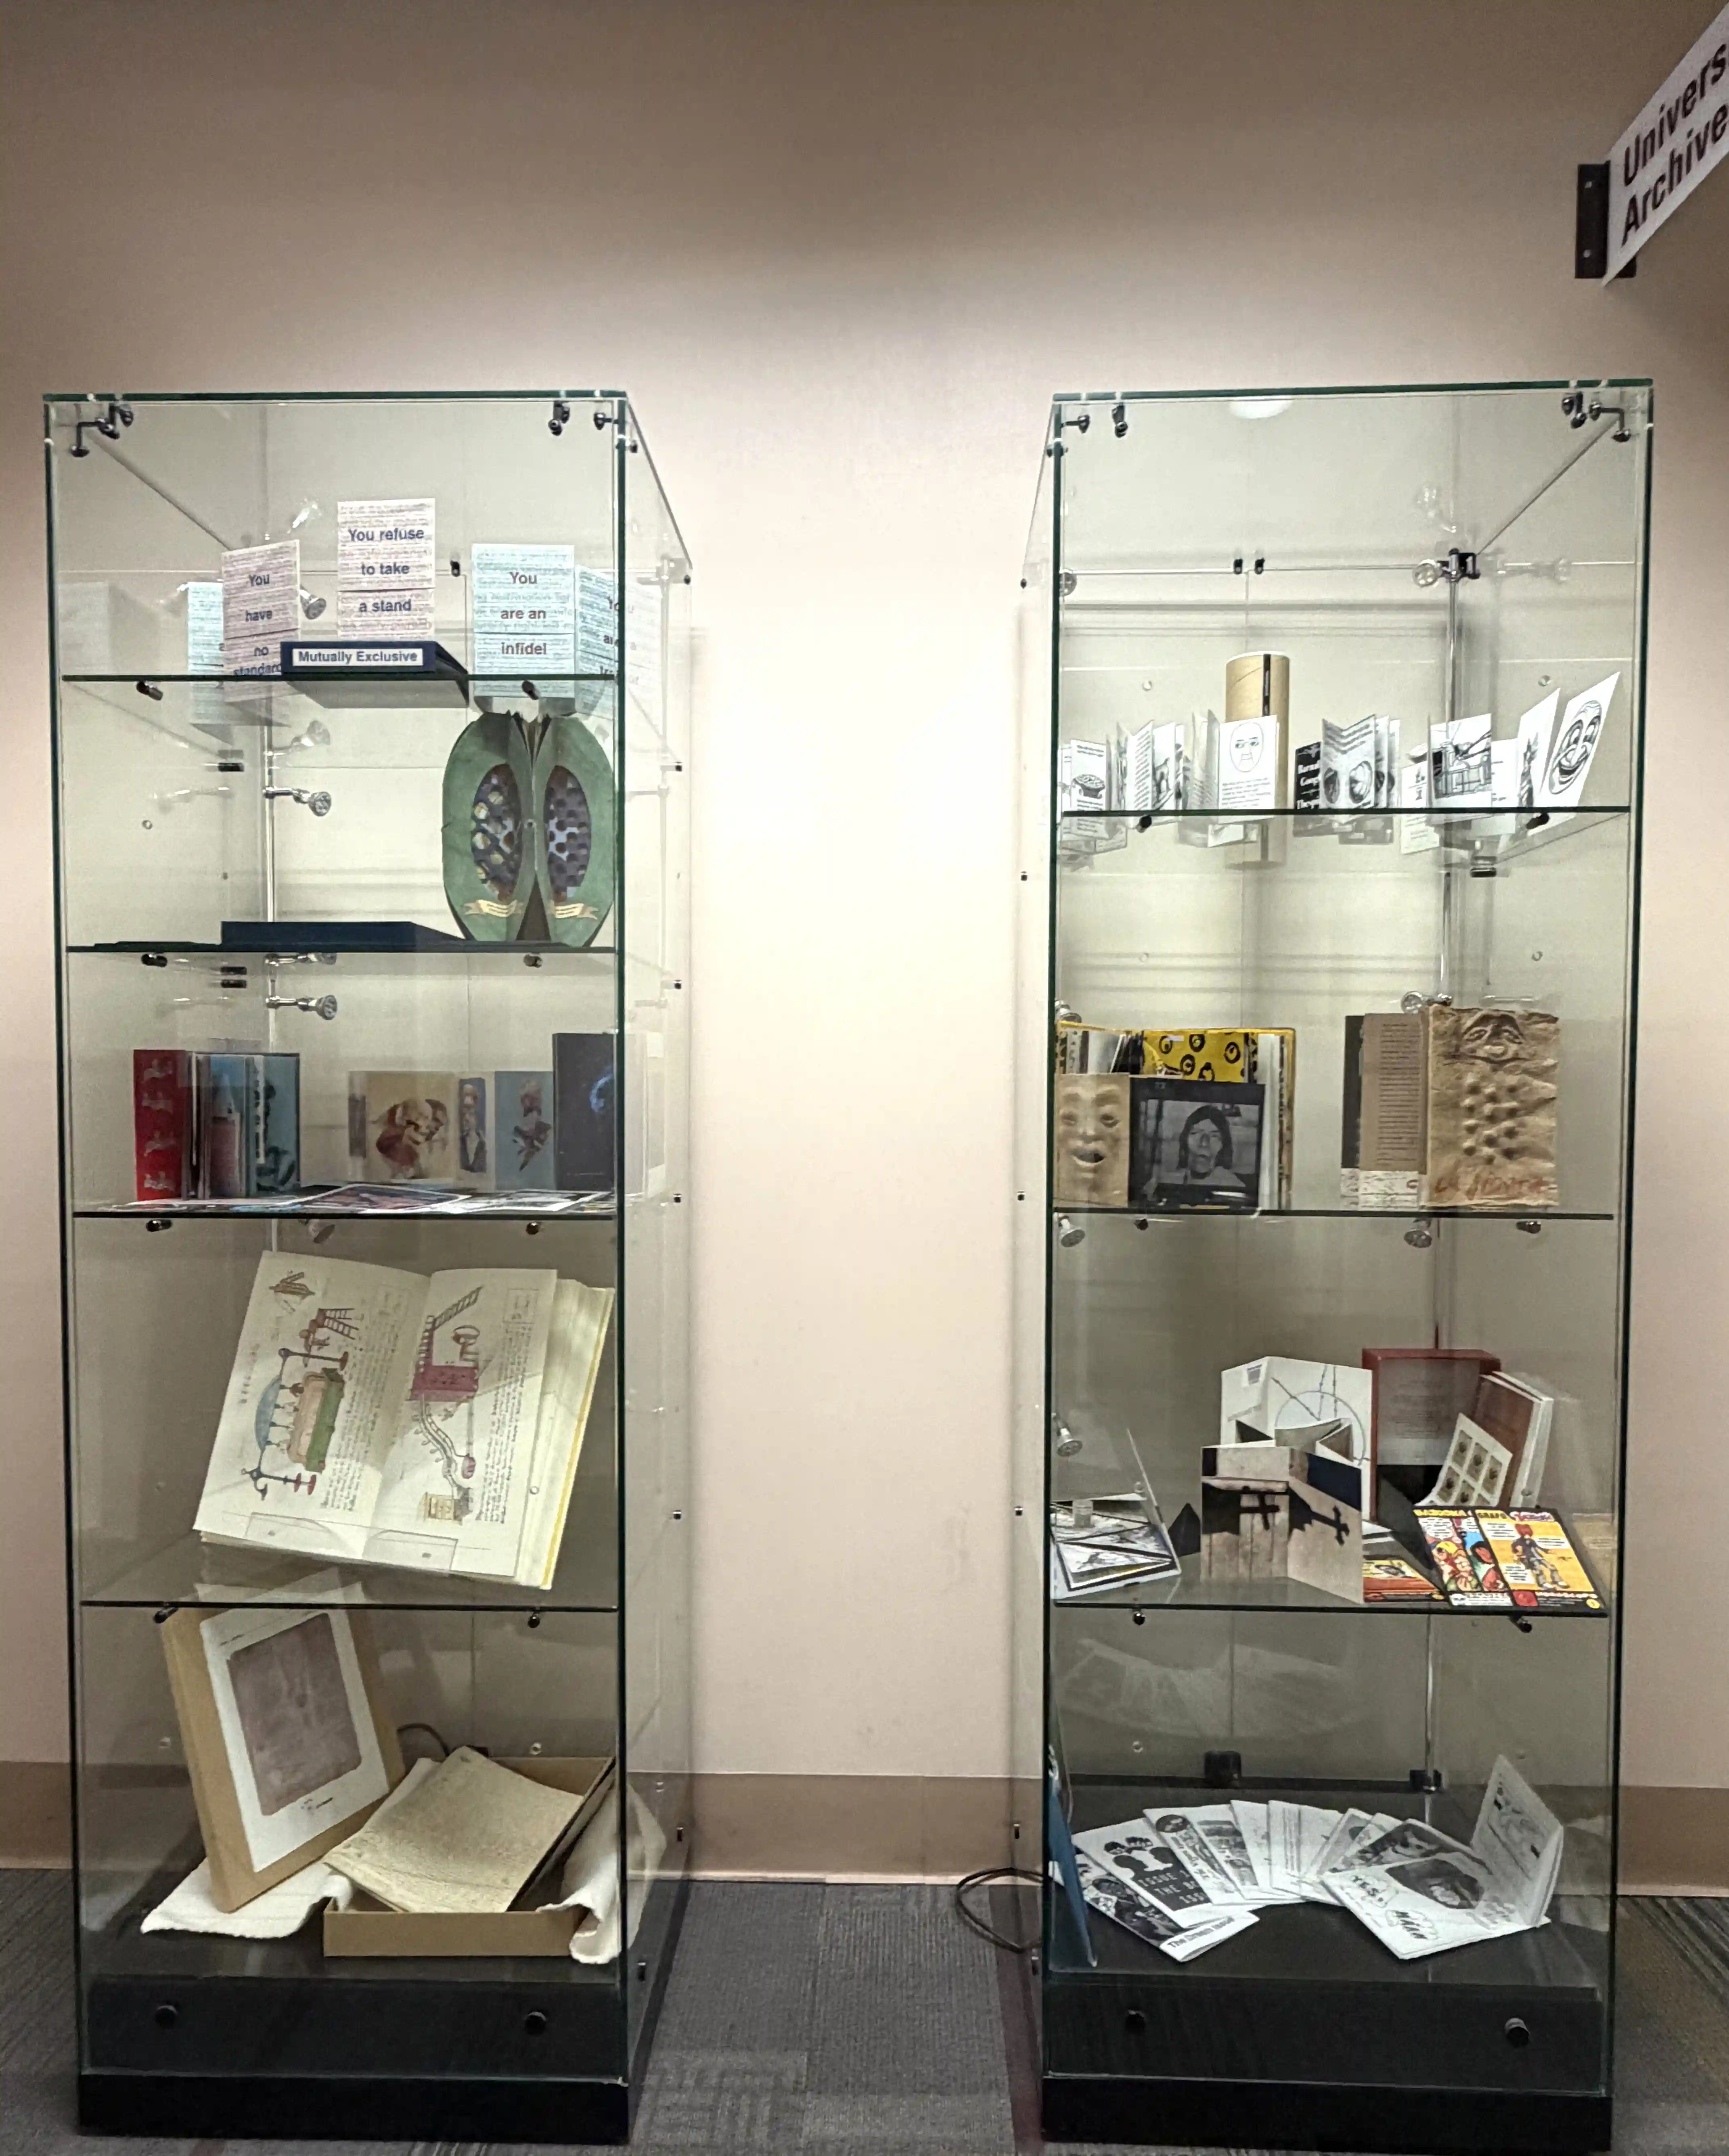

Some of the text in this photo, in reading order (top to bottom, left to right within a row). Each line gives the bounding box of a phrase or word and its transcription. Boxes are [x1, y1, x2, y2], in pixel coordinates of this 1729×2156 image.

[1624, 43, 1729, 187] Univers
[1621, 104, 1729, 247] Archive
[347, 527, 425, 542] You refuse
[361, 562, 410, 575] to take
[249, 574, 270, 587] You
[509, 571, 538, 585] You
[359, 599, 412, 612] a stand
[245, 609, 272, 623] have
[500, 609, 546, 620] are an
[253, 647, 269, 656] no
[500, 642, 547, 656] infidel
[298, 651, 418, 664] Mutually Exclusive
